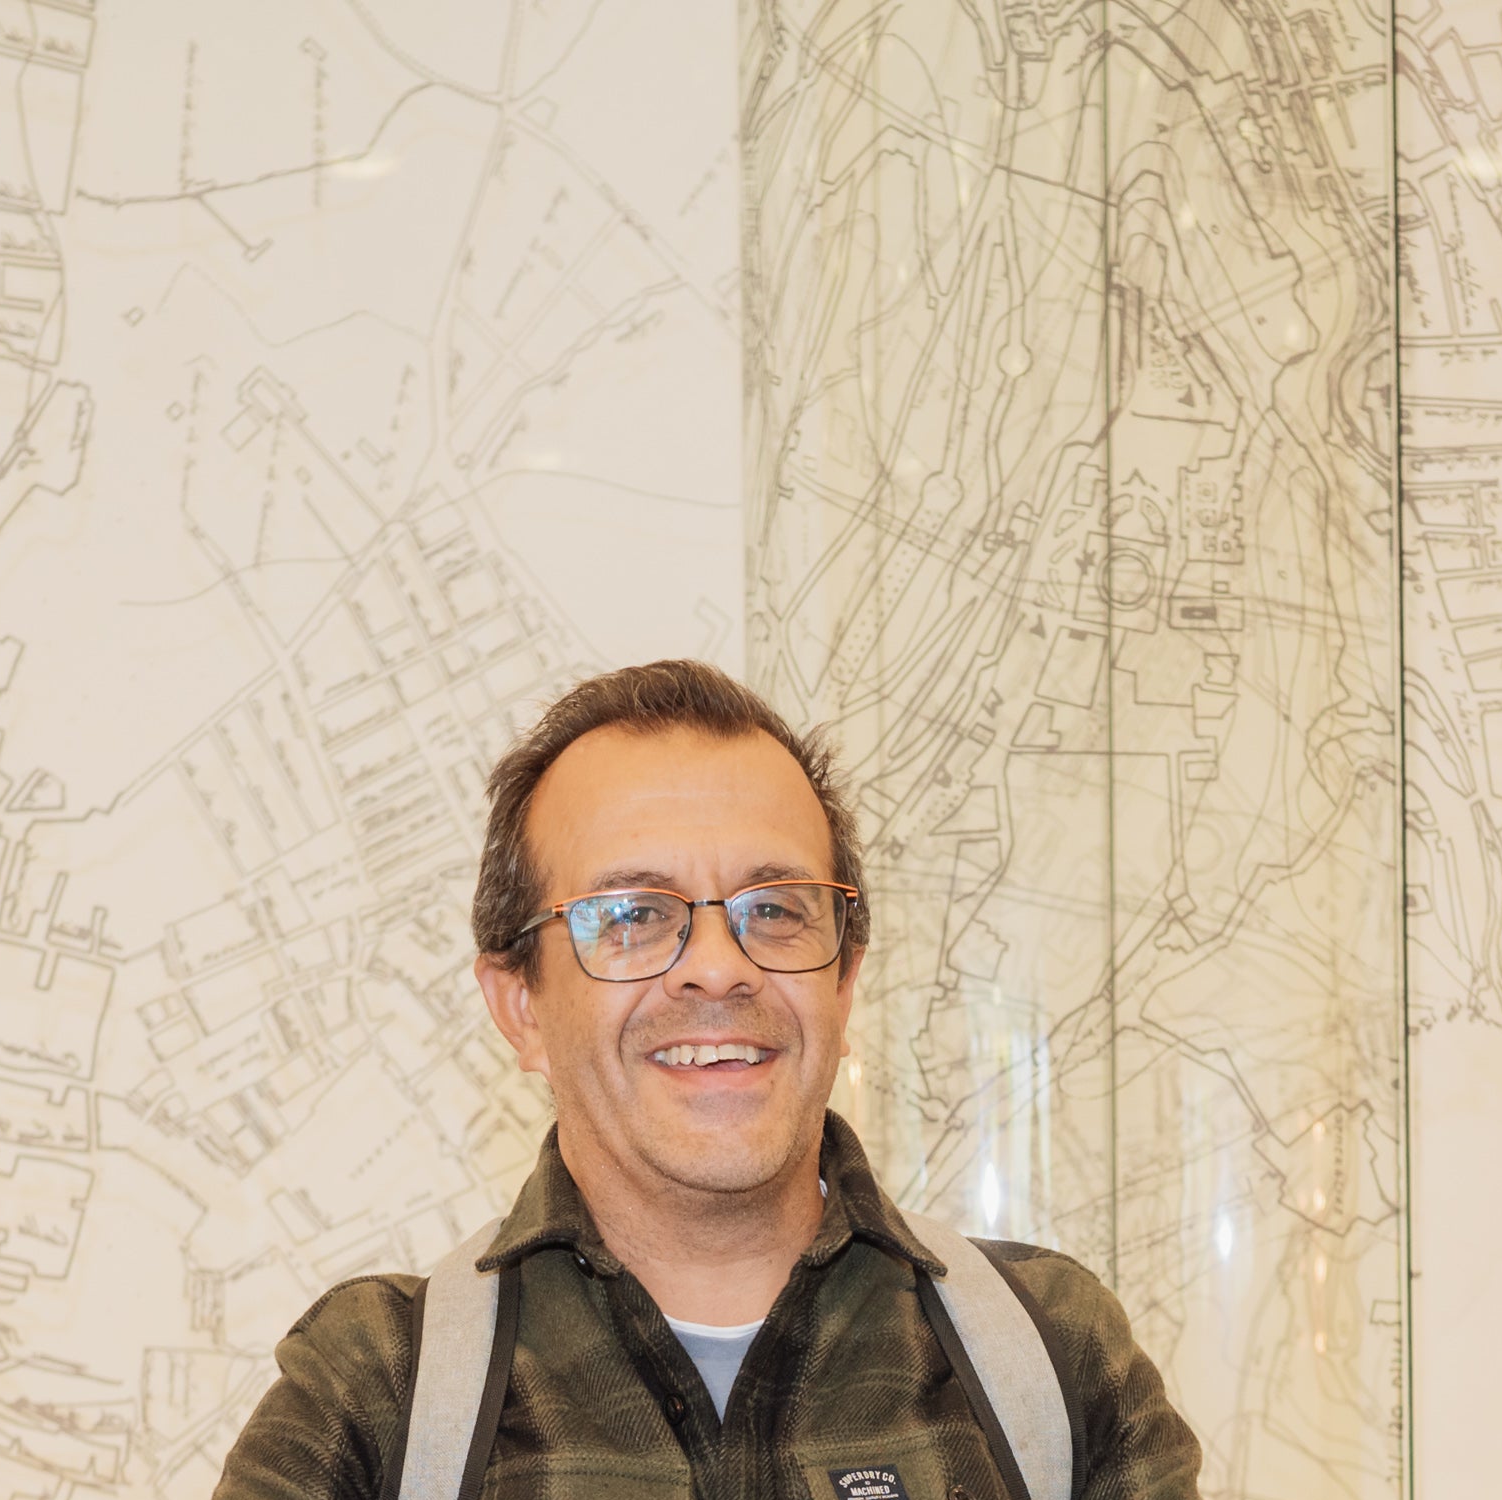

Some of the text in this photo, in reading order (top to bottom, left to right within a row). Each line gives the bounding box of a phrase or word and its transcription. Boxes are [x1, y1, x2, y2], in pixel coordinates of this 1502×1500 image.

[838, 1470, 897, 1488] SUPERDRY CO.
[850, 1485, 891, 1496] MACHINED
